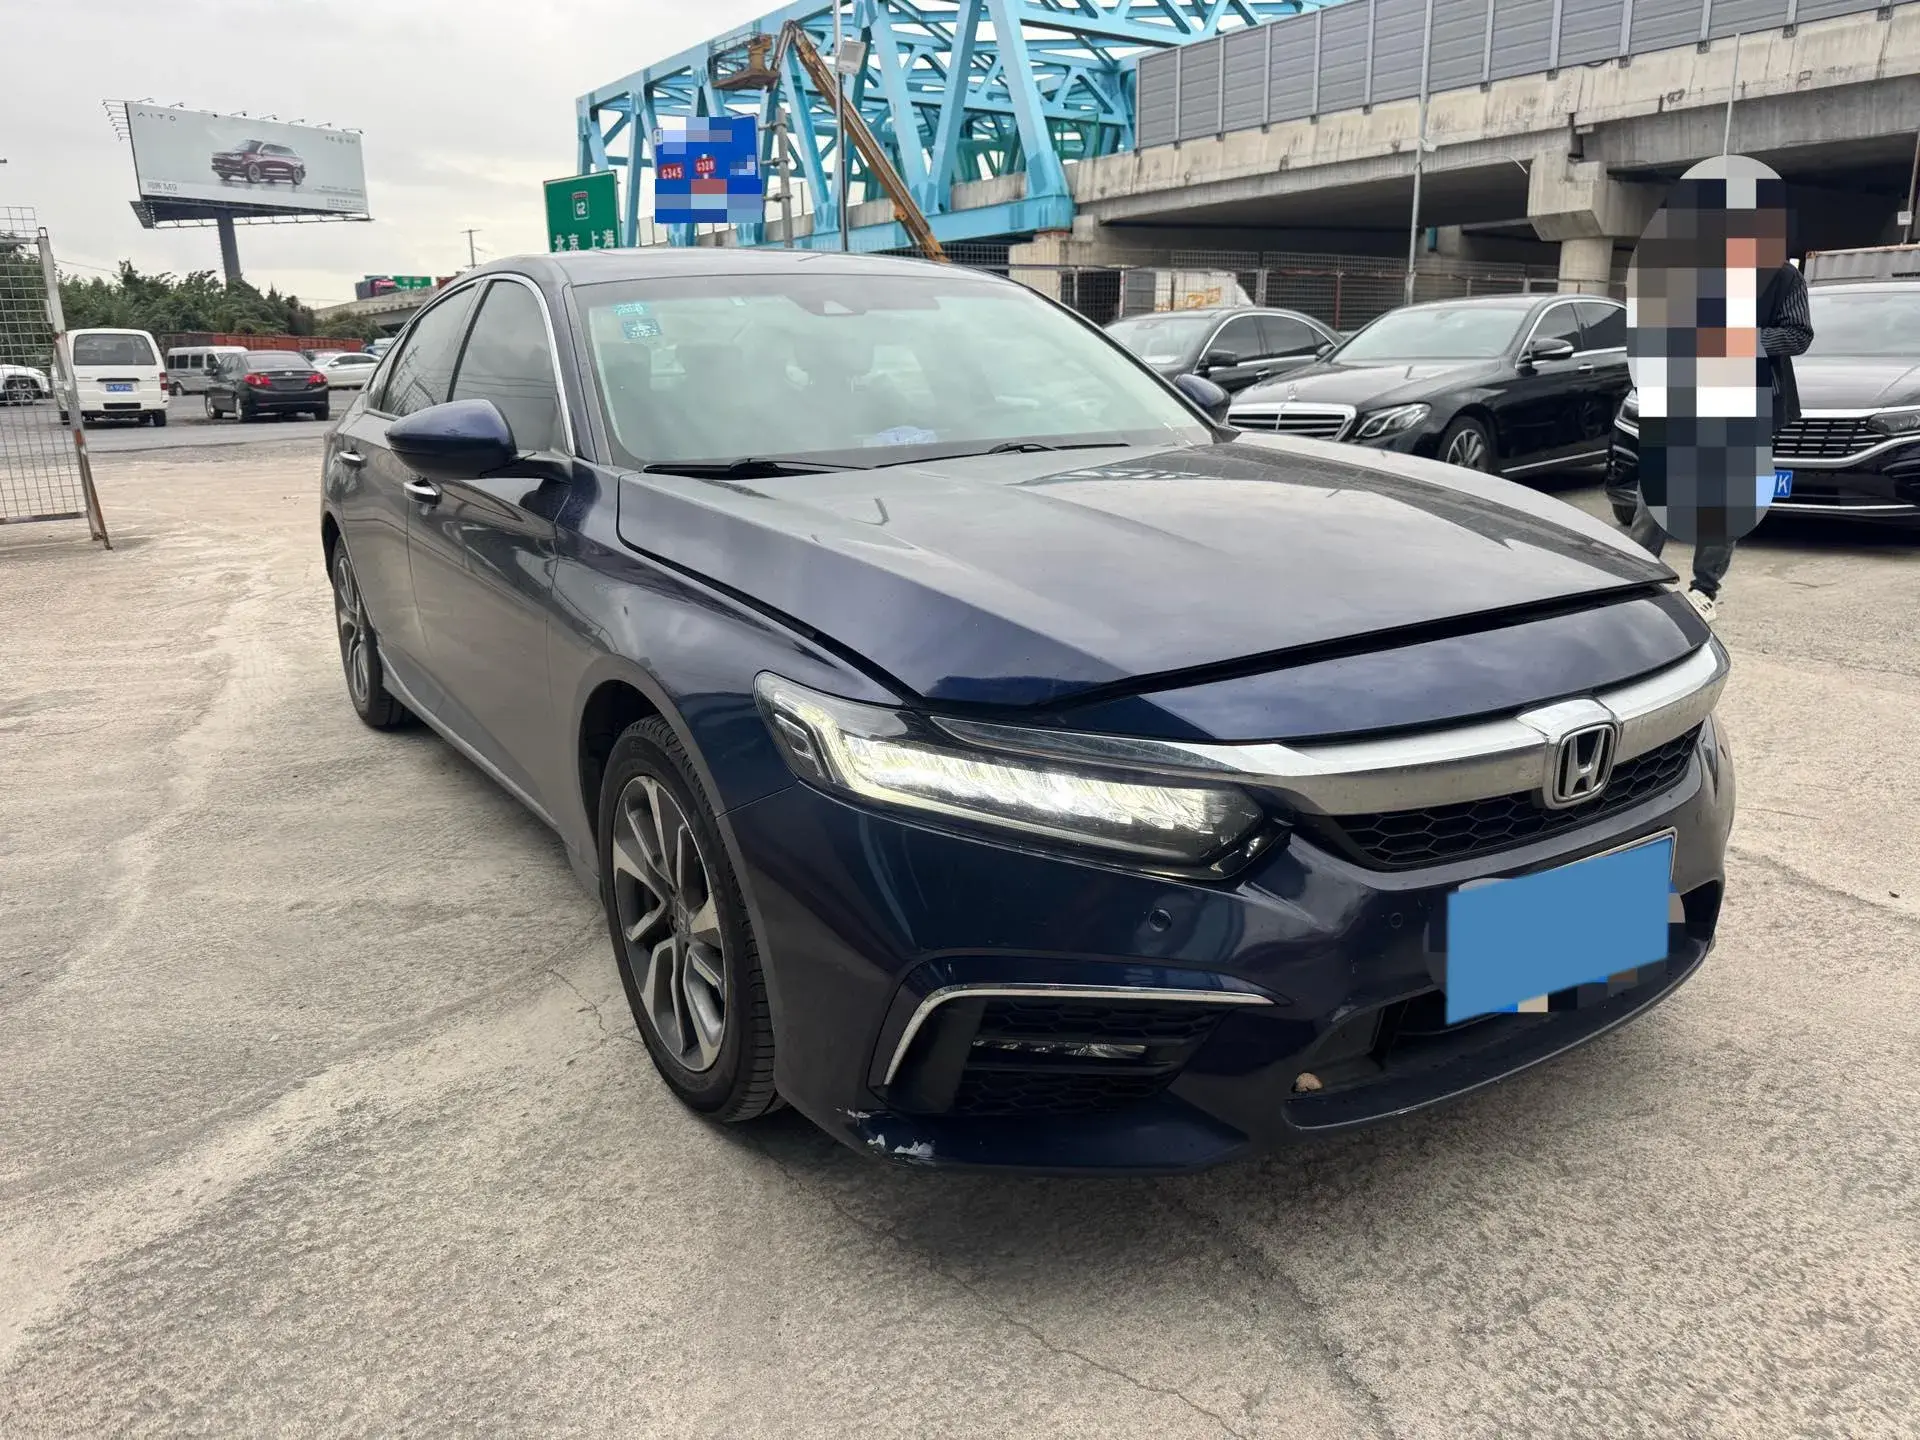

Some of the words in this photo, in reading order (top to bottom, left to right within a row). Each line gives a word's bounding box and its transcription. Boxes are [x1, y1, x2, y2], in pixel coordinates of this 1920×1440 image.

[661, 166, 683, 179] G345
[554, 232, 580, 251] 北京
[589, 228, 615, 249] 上海
